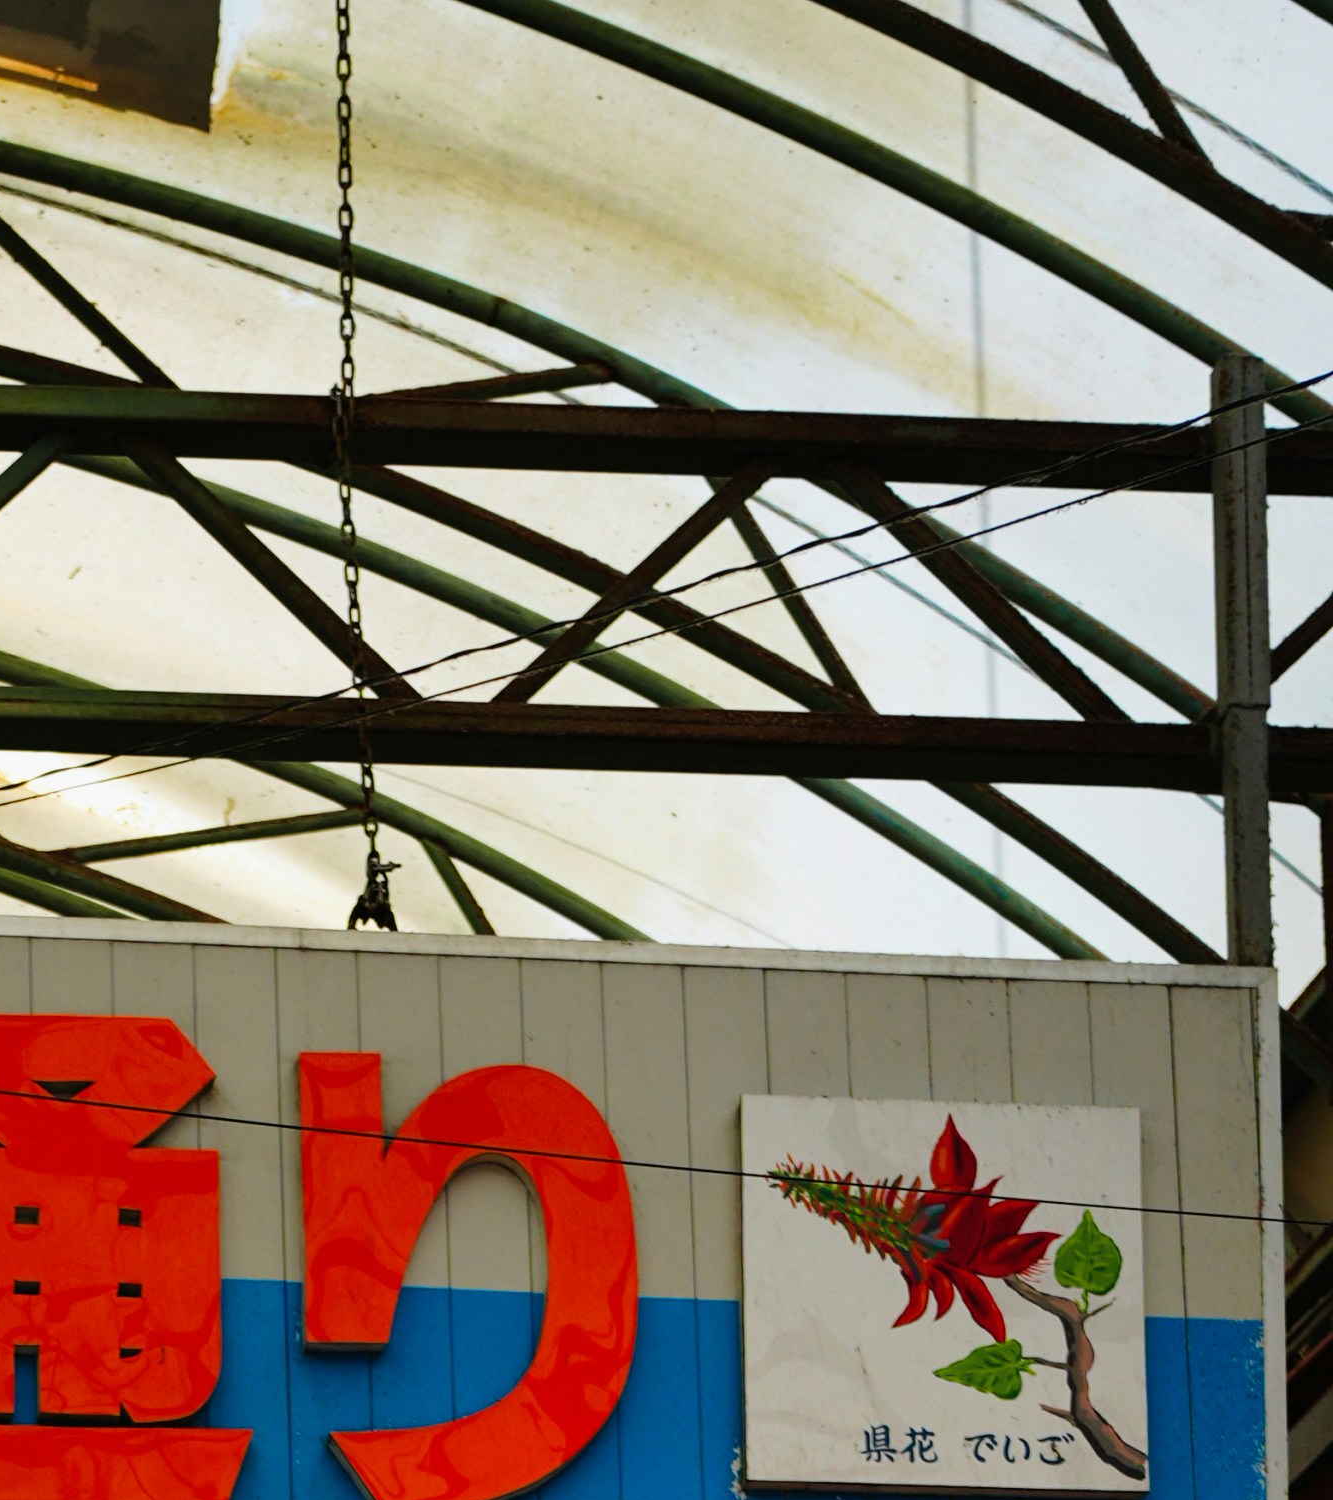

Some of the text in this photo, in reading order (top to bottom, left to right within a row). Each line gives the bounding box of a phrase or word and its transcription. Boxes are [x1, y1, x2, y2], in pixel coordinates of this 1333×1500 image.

[861, 1423, 1076, 1467] 県花 でいご
